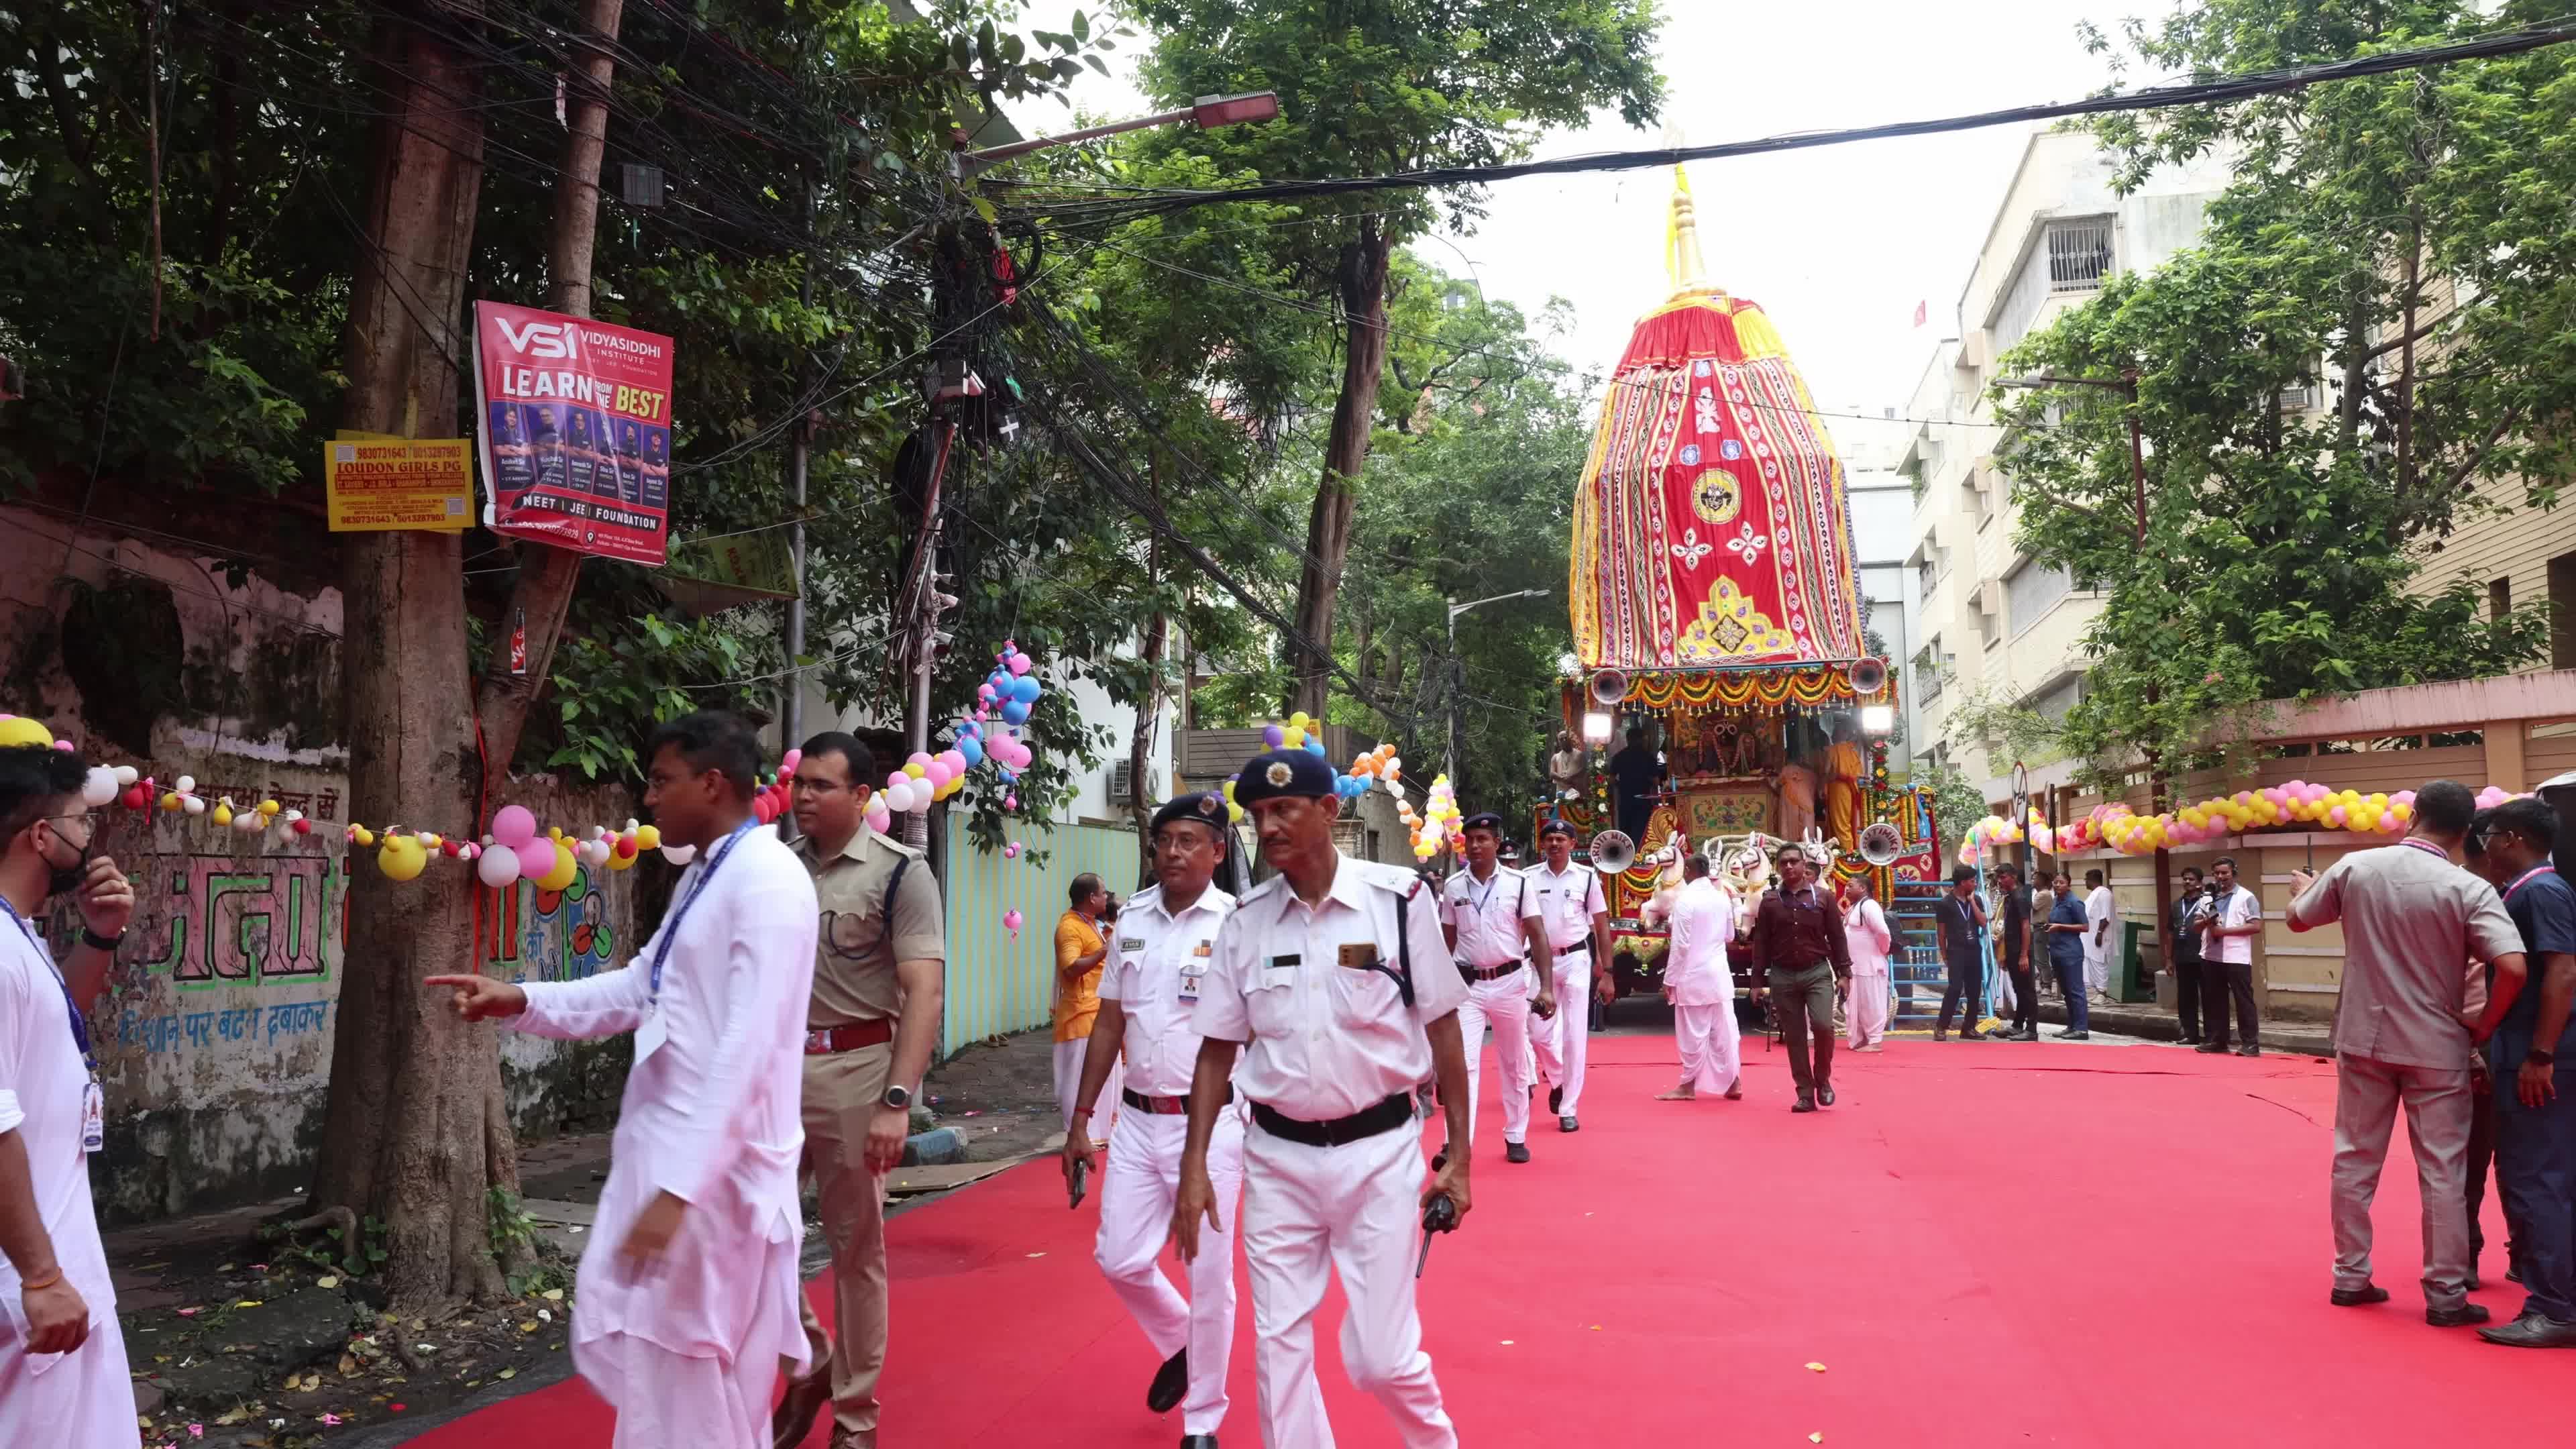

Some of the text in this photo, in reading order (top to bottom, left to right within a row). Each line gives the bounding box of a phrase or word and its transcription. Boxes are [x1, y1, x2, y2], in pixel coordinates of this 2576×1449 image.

[580, 329, 660, 358] VIDYASIDDHI
[597, 348, 644, 364] INSTITUTE
[503, 366, 592, 402] LEARN
[594, 380, 612, 394] FROM
[596, 394, 610, 409] THE
[615, 386, 664, 419] BEST
[337, 462, 462, 473] LOUDON GIRLS PG
[523, 495, 656, 529] NEET JEE FOUNDATION
[1593, 832, 1632, 864] SRUTI MIKE
[184, 1012, 215, 1048] पर
[267, 1001, 329, 1047] दबाकर
